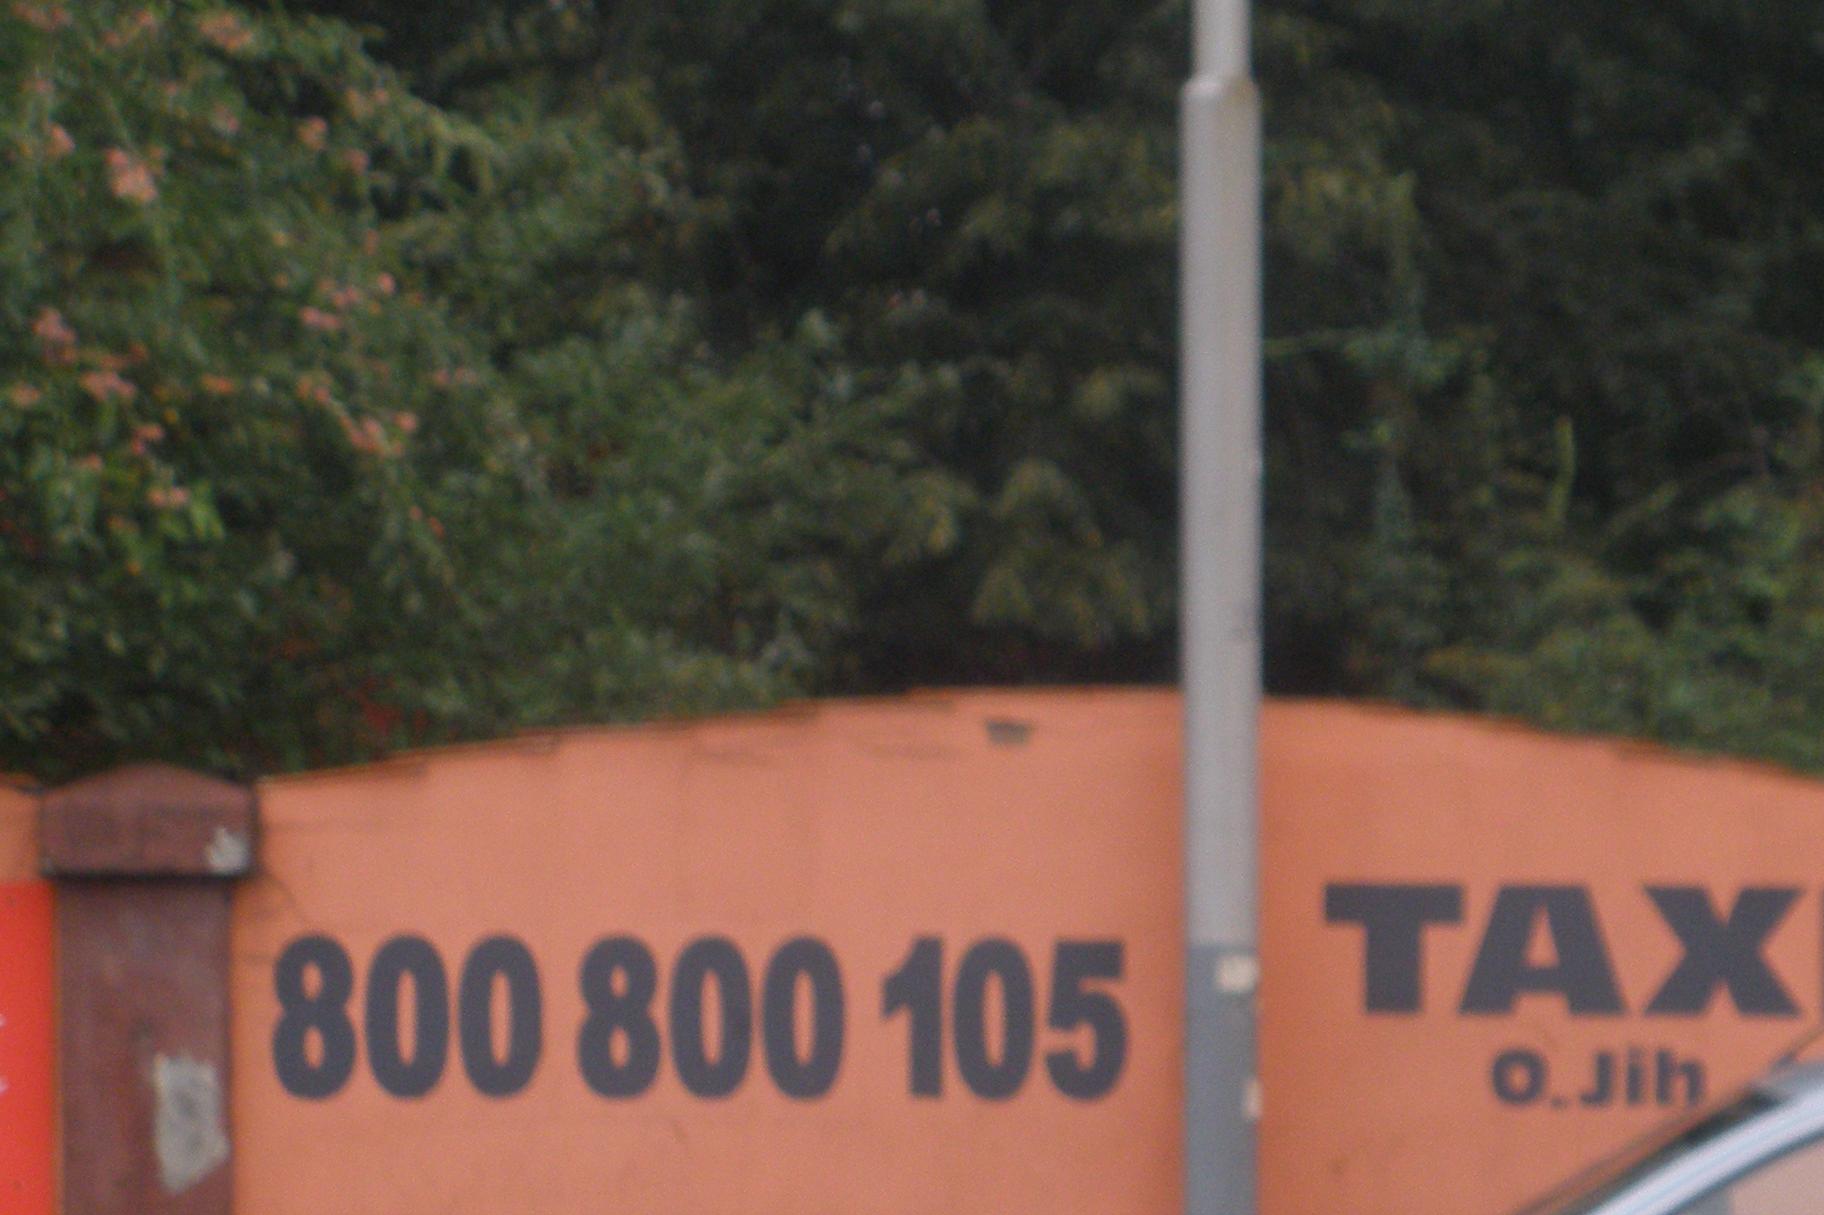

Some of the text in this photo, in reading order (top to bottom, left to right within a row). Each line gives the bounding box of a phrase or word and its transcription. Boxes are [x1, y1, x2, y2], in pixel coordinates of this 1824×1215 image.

[271, 933, 1130, 1103] 800 800 105
